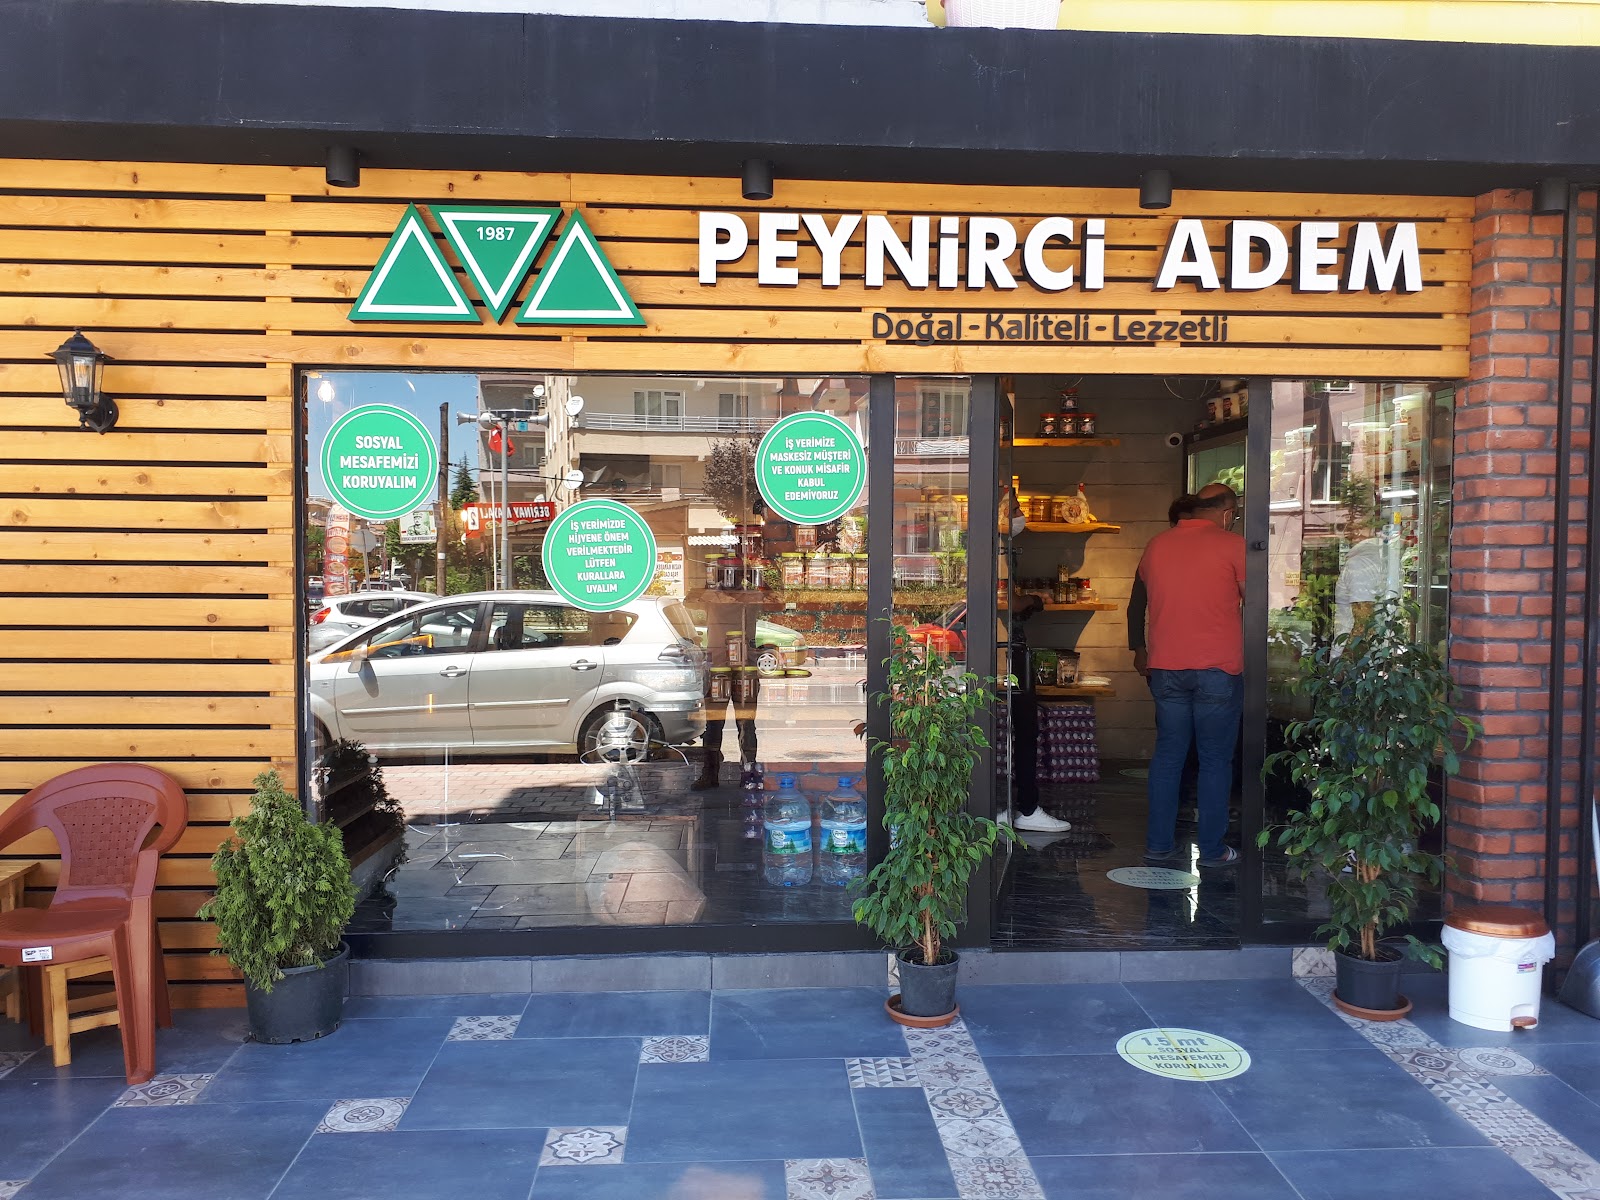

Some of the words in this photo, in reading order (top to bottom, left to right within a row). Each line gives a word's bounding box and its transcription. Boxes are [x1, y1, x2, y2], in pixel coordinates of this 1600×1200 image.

[476, 226, 515, 241] 1987
[1151, 218, 1423, 294] ADEM
[872, 312, 962, 346] Doğal
[985, 313, 1090, 341] Kaliteli
[1113, 314, 1228, 342] Lezzetli
[355, 435, 404, 449] SOSYAL
[785, 437, 794, 450] İŞ
[795, 436, 836, 448] YERİMİZE
[339, 452, 419, 470] MESAFEMİZİ
[769, 450, 812, 462] MASKESİZ
[813, 449, 851, 463] MÜŞTERİ
[771, 465, 783, 475] VE
[784, 464, 814, 475] KONUK
[815, 462, 850, 475] MİSAFİR
[342, 475, 417, 489] KORUYALIM
[797, 477, 826, 488] KABUL
[784, 489, 839, 501] EDEMİYORUZ
[570, 519, 579, 532] İŞ
[580, 518, 626, 530] YERİMİZDE
[568, 532, 603, 544] HİJYENE
[604, 531, 629, 542] ÖNEM
[566, 543, 633, 556] VERİLMEKTEDİR
[585, 557, 616, 568] LÜTFEN
[577, 570, 626, 581] KURALLARA
[586, 583, 618, 593] UYALIM
[1141, 1037, 1169, 1047] 1.5
[1177, 1037, 1208, 1047] mt
[1147, 1053, 1225, 1062] MESAFEMİZİ
[1155, 1062, 1229, 1070] KORUYALIM
